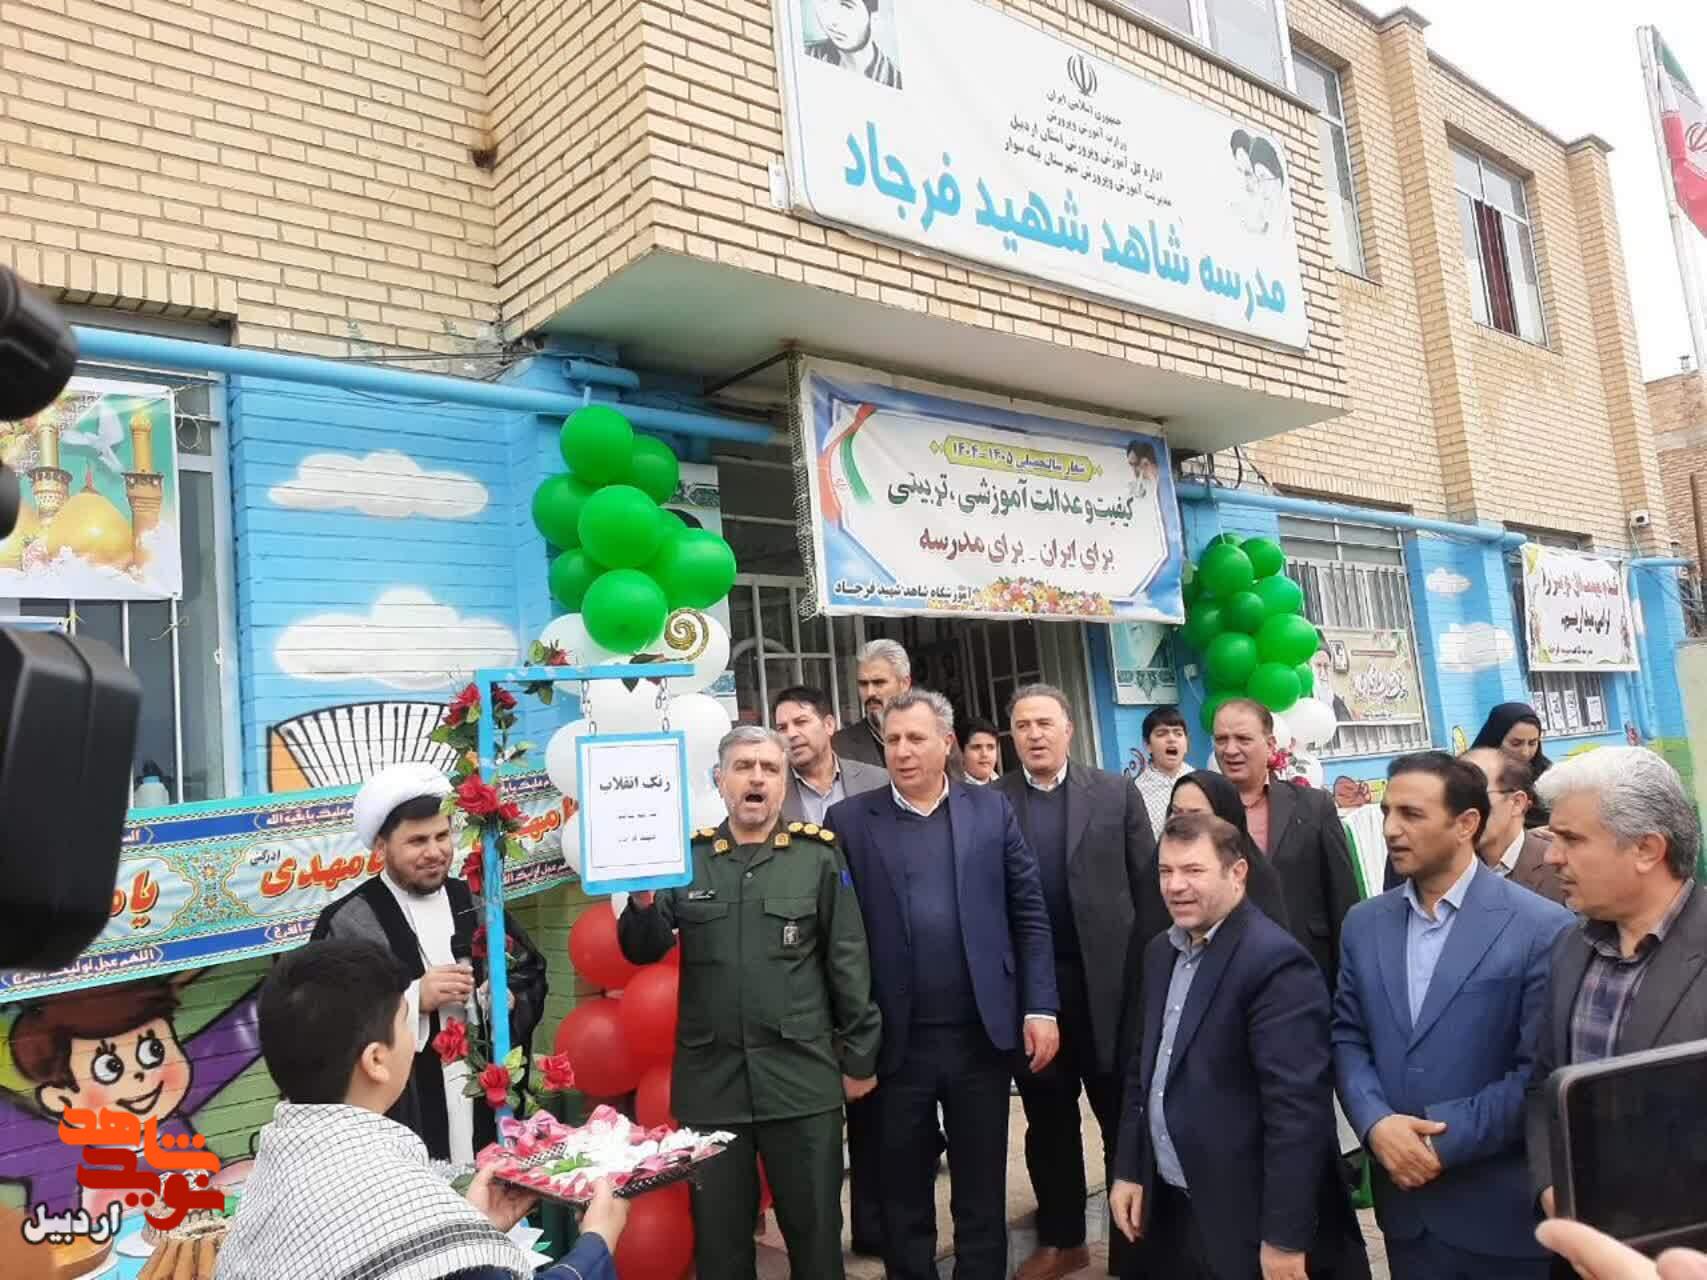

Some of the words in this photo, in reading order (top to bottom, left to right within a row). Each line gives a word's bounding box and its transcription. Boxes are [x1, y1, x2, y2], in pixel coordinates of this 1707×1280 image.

[844, 121, 961, 231] فرجاد
[975, 178, 1090, 254] شهید
[1102, 218, 1190, 286] شاهد
[1199, 256, 1286, 321] مدرسه
[1034, 486, 1083, 515] عدالت
[919, 527, 985, 561] مدرسه
[988, 533, 1024, 564] برای
[1040, 540, 1077, 569] ایران
[1080, 537, 1115, 574] برای
[599, 775, 639, 795] انقلاب
[260, 853, 365, 898] مهدی
[130, 869, 160, 929] یا
